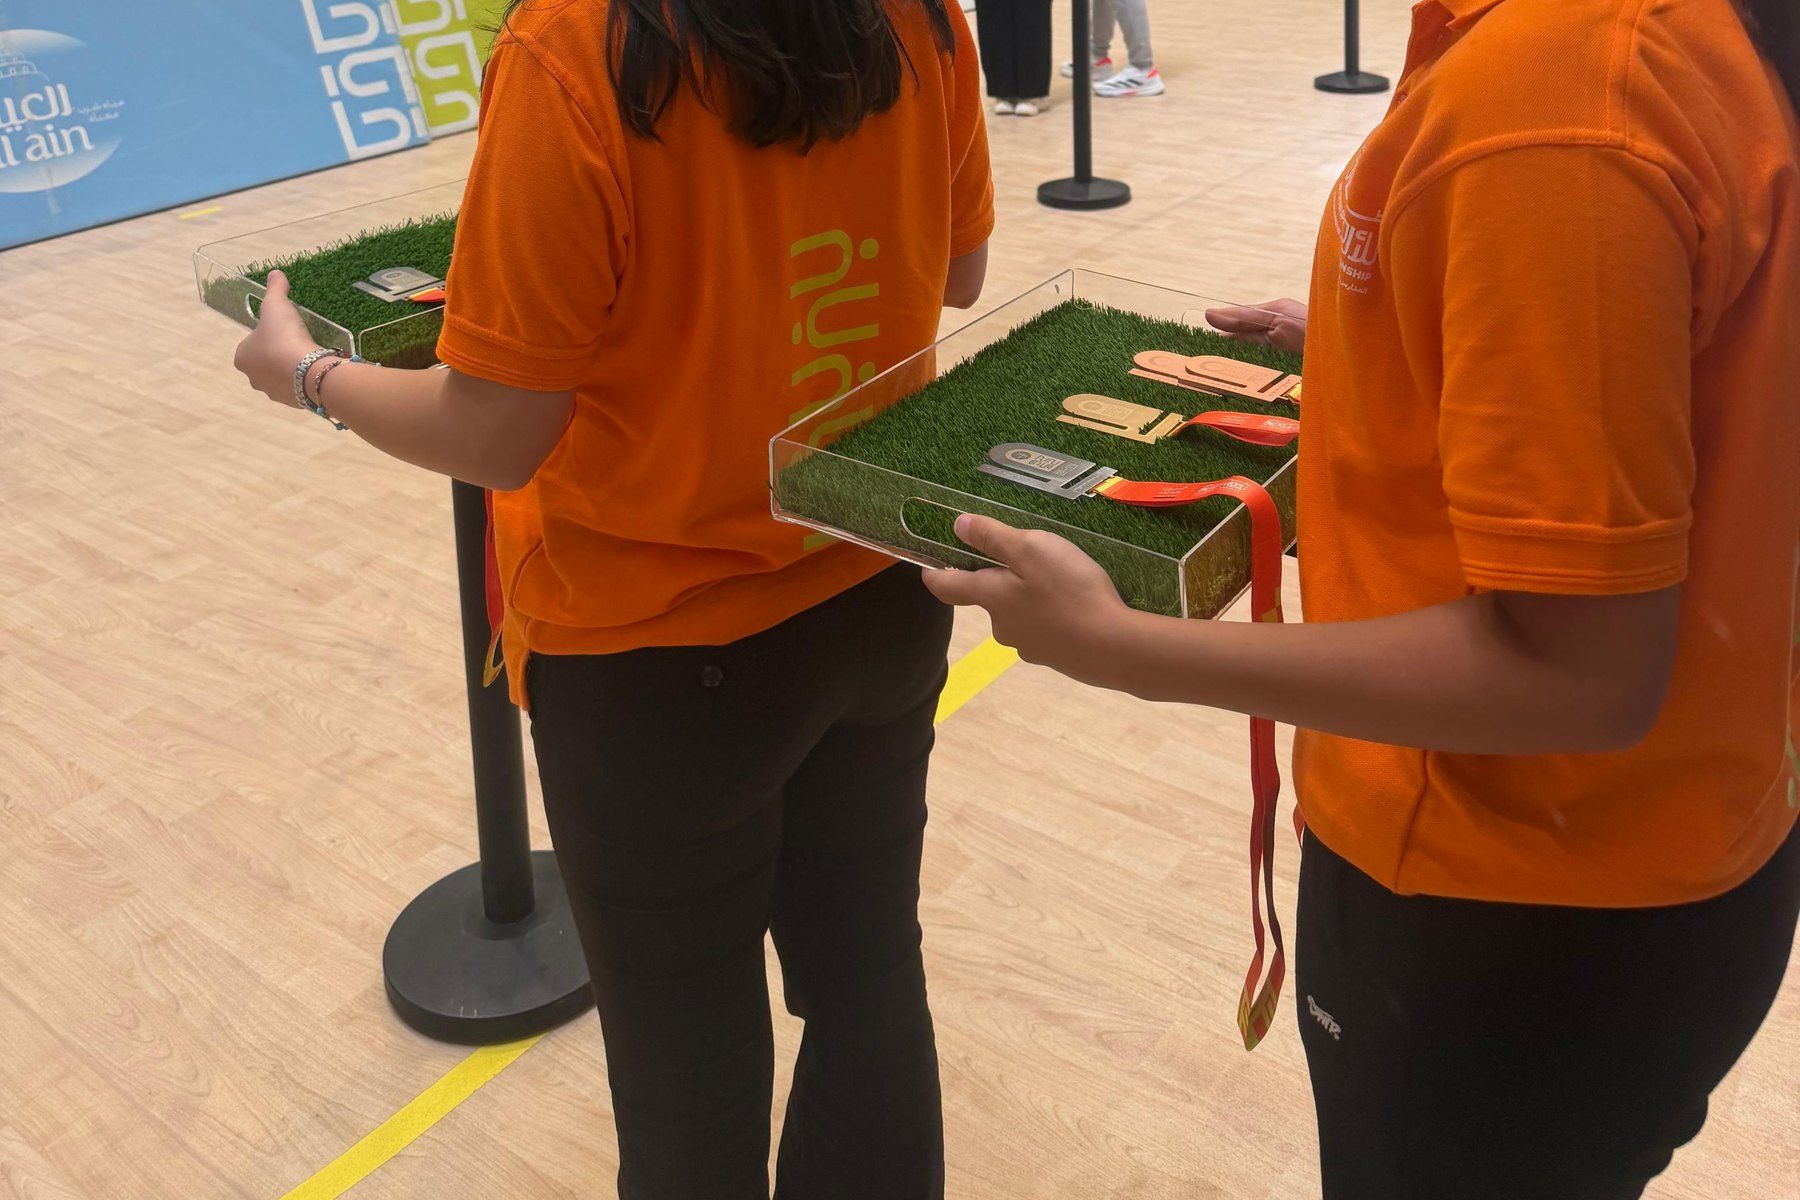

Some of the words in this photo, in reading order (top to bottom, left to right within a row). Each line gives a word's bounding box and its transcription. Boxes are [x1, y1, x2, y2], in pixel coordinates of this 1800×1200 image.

[0, 83, 72, 132] العي
[0, 134, 20, 169] l
[25, 123, 95, 162] ain
[1339, 260, 1372, 280] NSHIP
